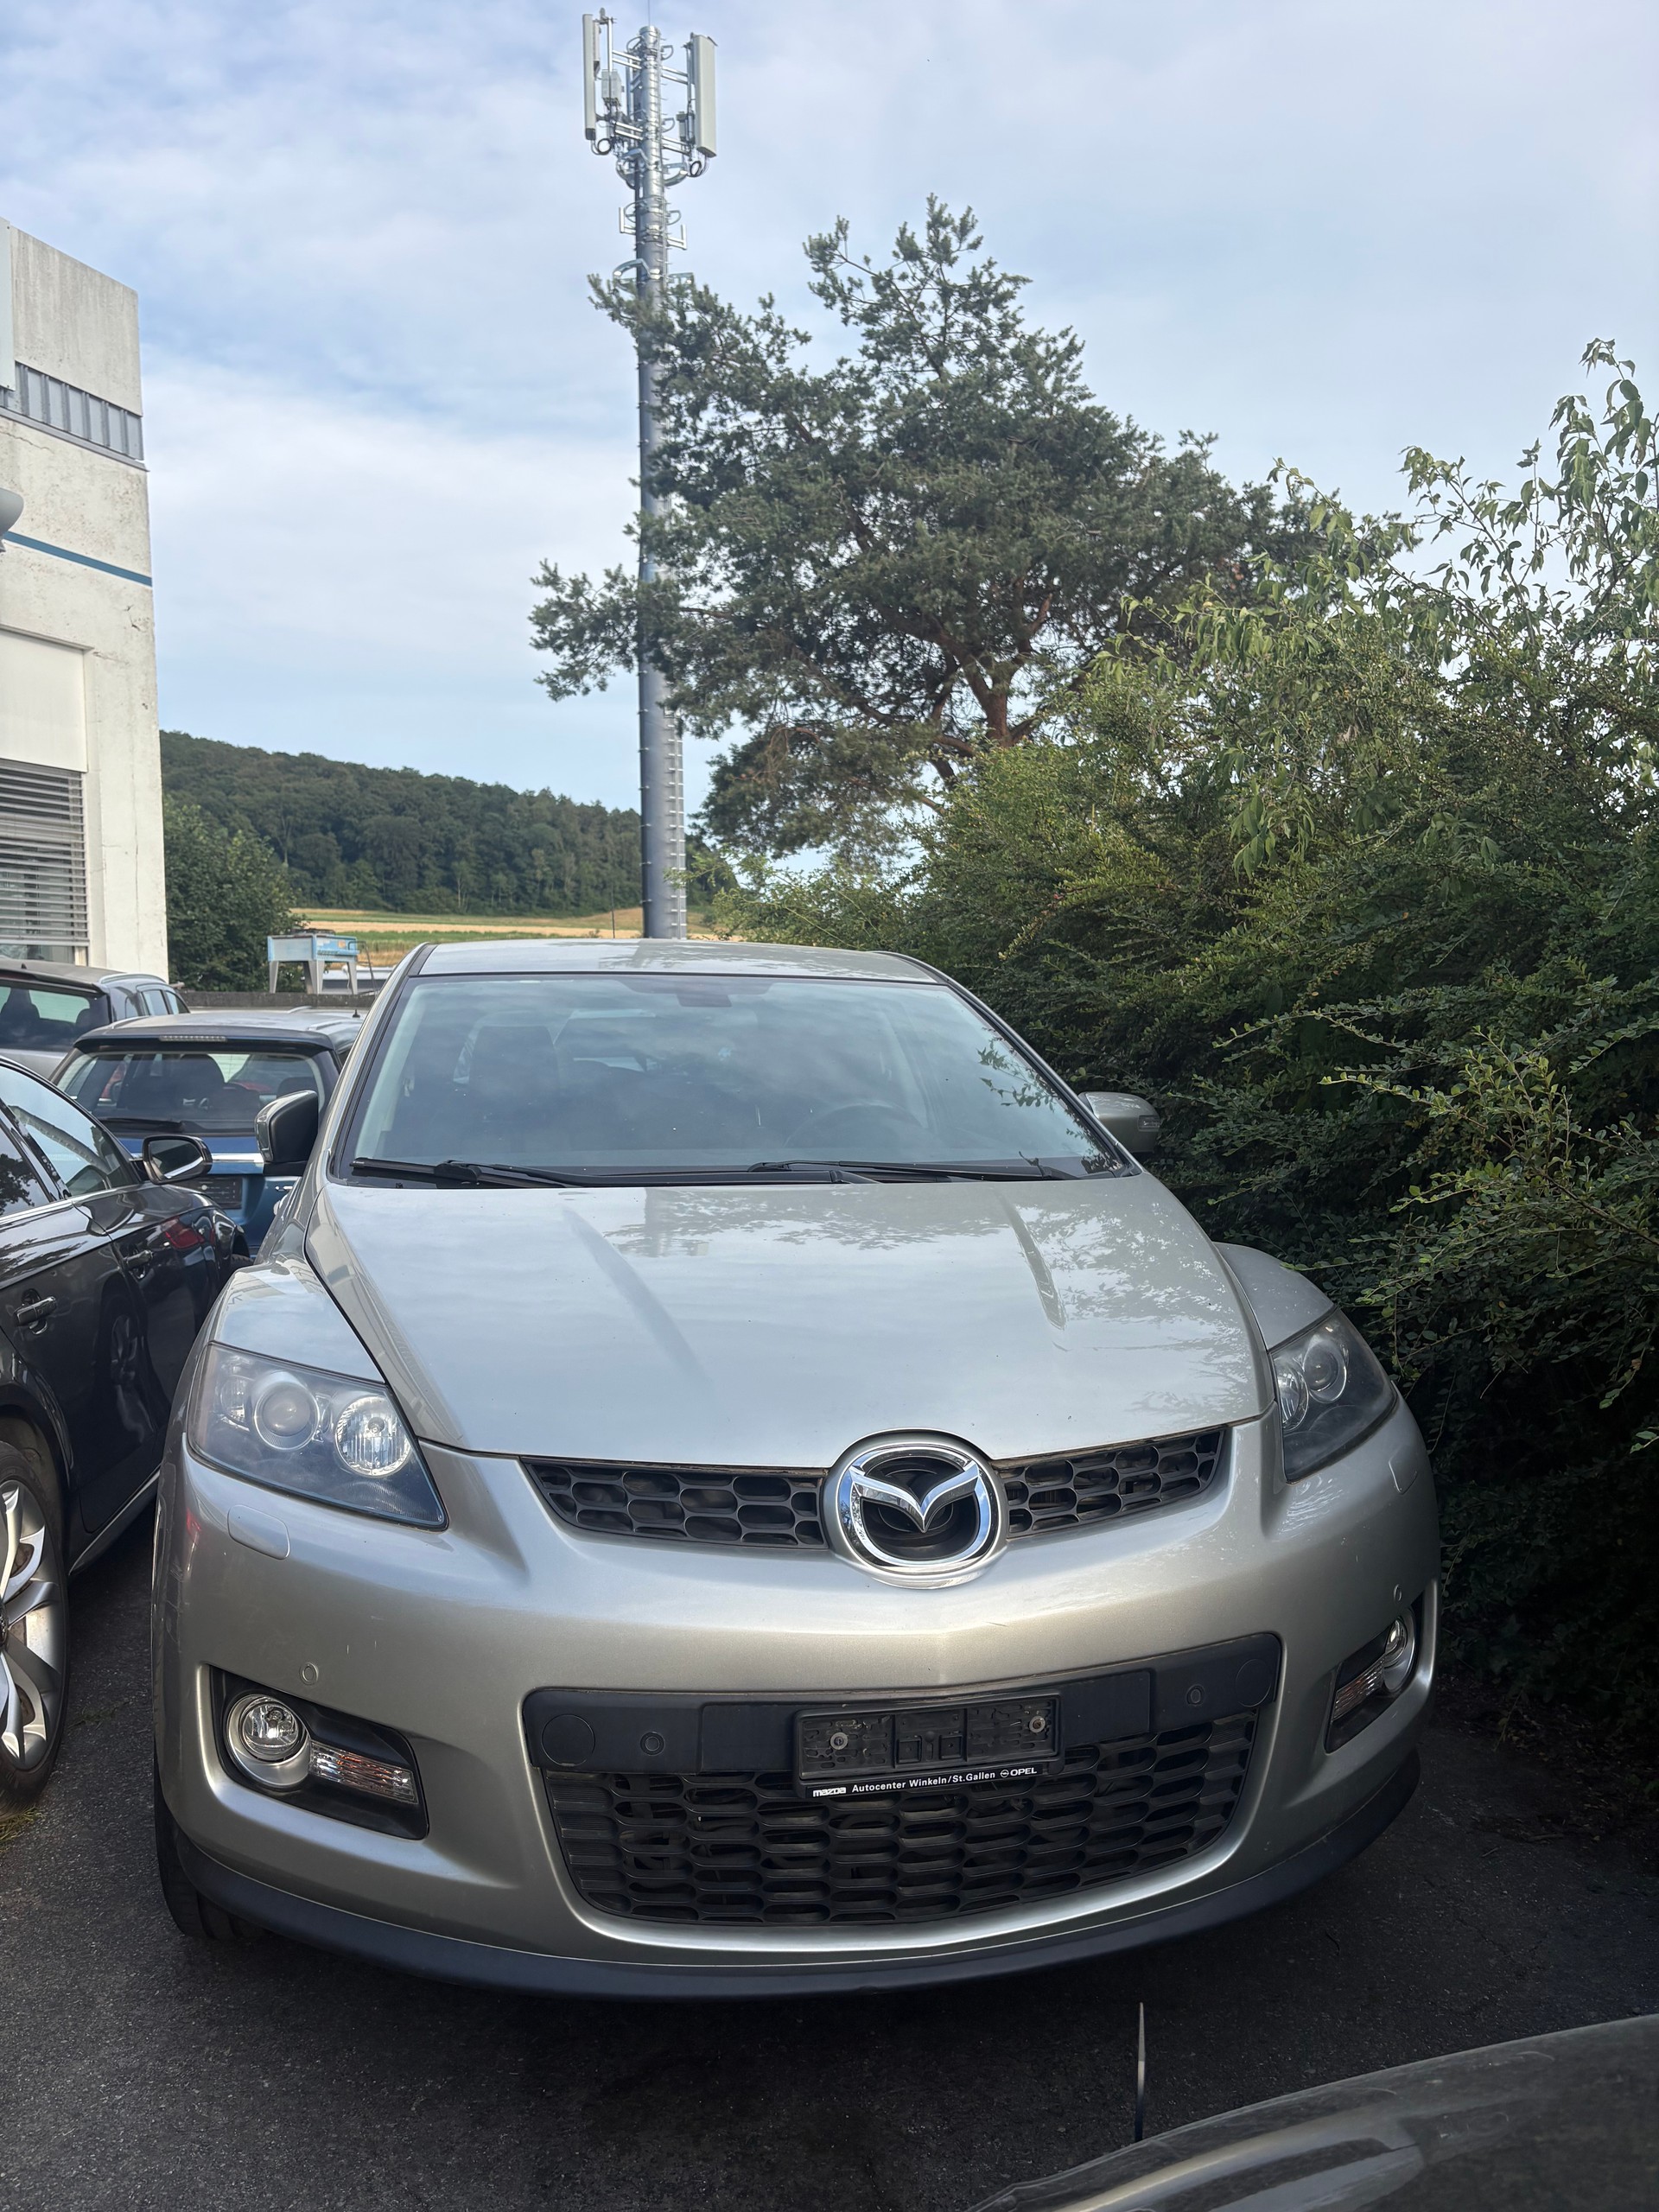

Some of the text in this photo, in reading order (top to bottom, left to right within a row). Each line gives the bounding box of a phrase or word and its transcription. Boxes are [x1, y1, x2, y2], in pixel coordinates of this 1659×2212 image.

[851, 1783, 906, 1793] Autocenter
[908, 1771, 995, 1788] Winkeln/St.Gallen
[1010, 1767, 1037, 1777] OPEL
